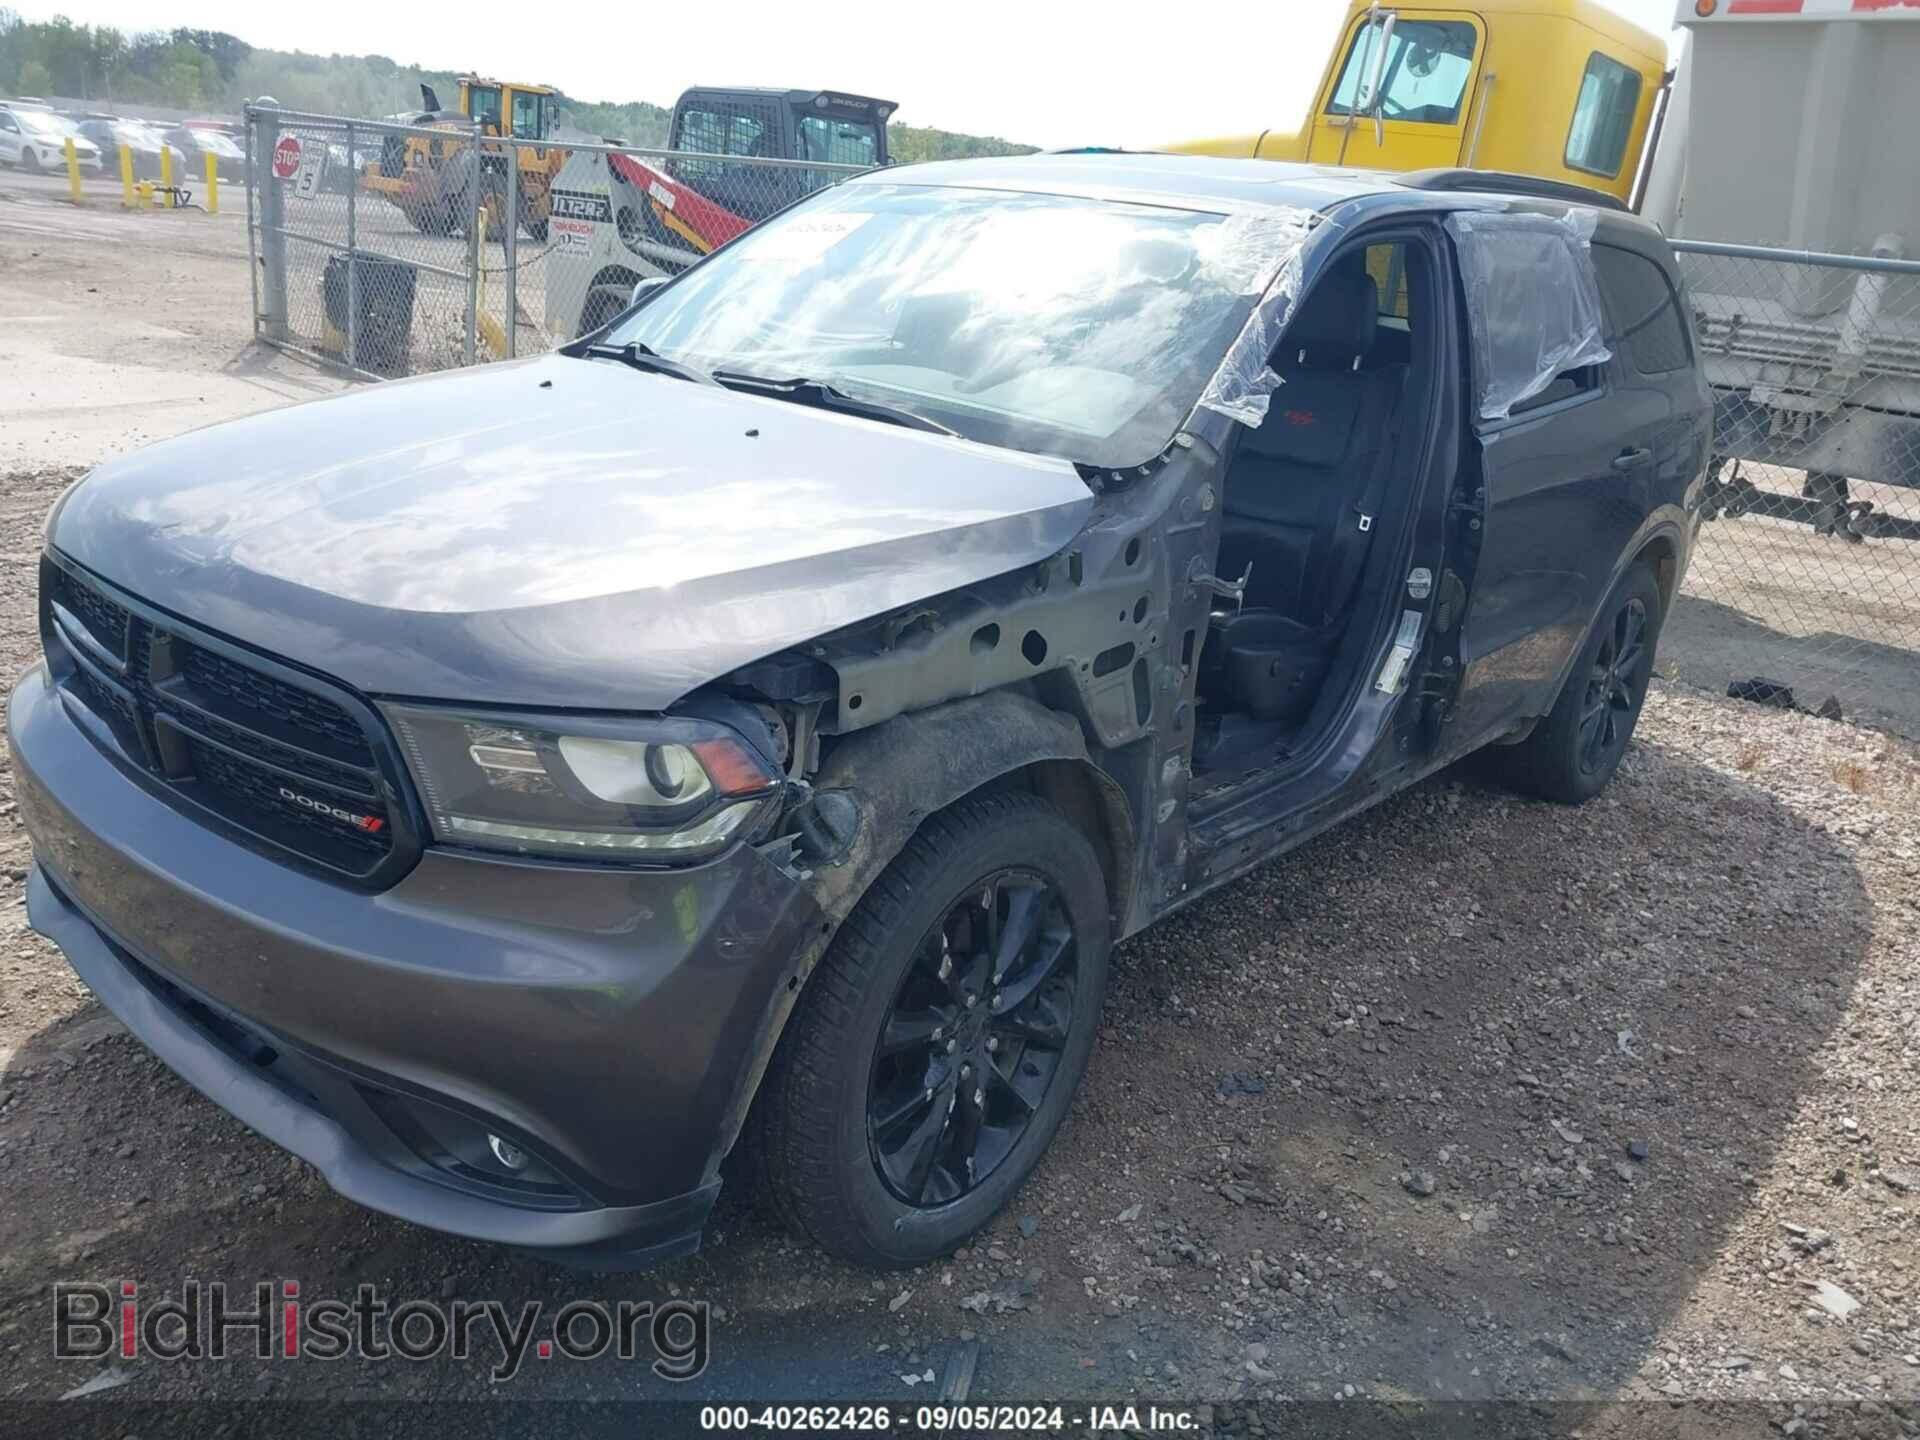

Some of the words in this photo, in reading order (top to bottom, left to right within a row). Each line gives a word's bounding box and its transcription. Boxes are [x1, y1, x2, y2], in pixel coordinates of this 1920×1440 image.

[276, 149, 300, 167] STOP
[301, 173, 313, 191] 5
[280, 788, 369, 828] DODGE
